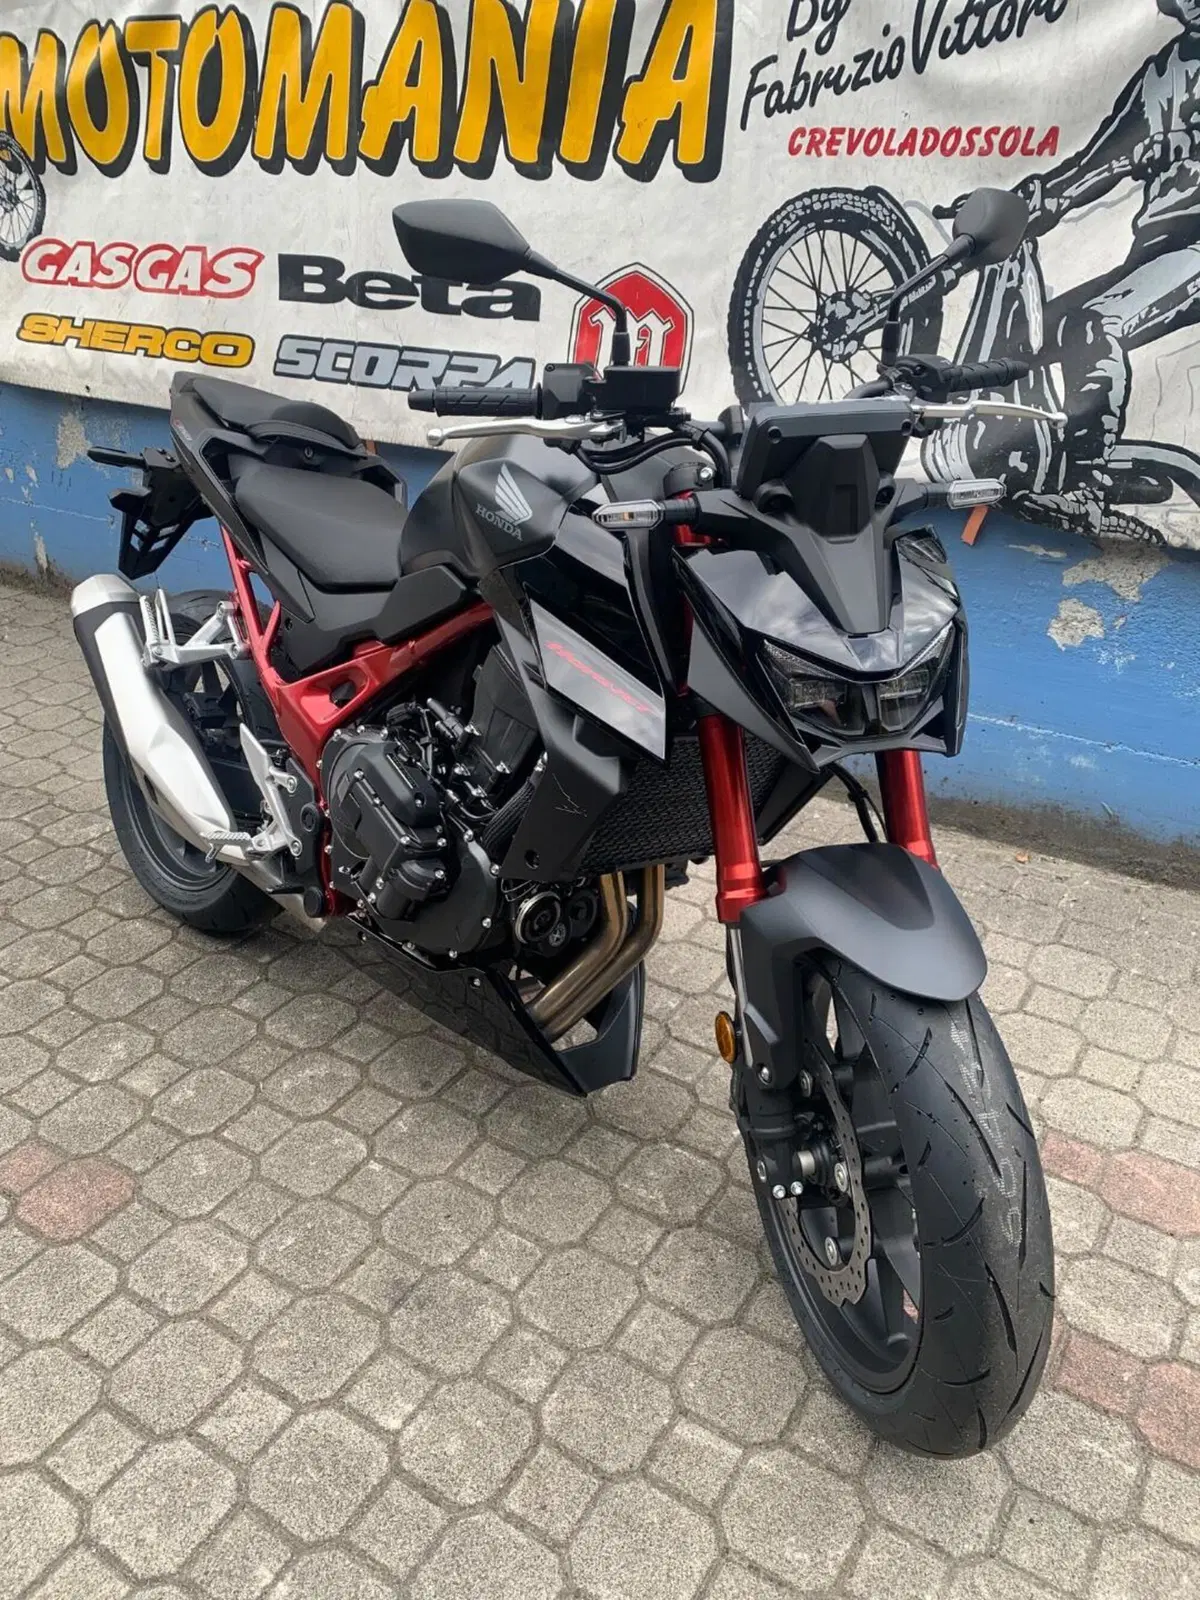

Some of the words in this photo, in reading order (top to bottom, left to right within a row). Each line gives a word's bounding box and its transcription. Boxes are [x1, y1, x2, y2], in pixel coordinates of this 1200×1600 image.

[0, 0, 734, 182] MOTOMANIA
[787, 125, 1060, 157] CREVOLADOSSOLA
[278, 252, 541, 322] Beta
[16, 312, 256, 368] SHERCO
[273, 334, 536, 392] SCORPA
[475, 503, 523, 541] HONDA
